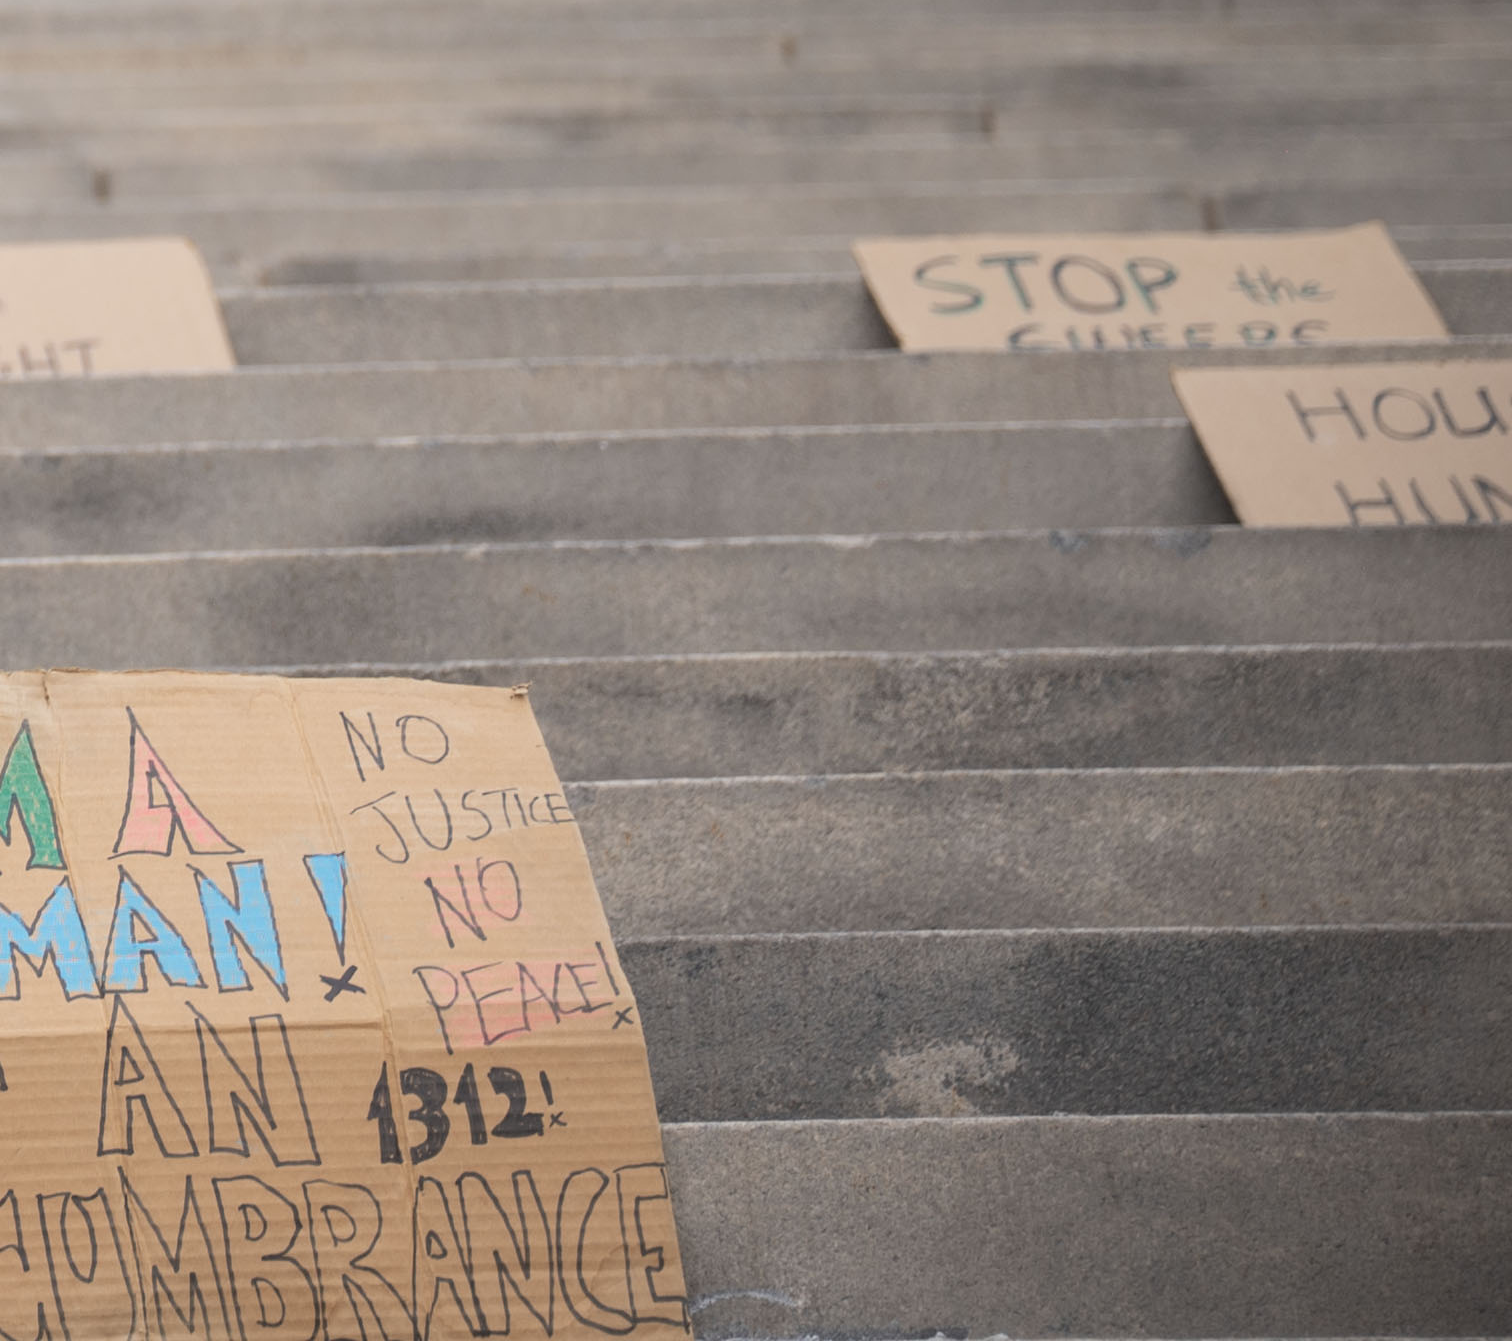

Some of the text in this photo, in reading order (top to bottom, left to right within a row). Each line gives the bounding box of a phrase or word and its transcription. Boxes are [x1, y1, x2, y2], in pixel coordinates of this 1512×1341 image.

[914, 250, 1334, 317] STOP the
[1285, 386, 1512, 443] HOU
[110, 705, 244, 859] A
[339, 710, 449, 782] NO
[349, 788, 577, 864] JUSTICE
[424, 857, 522, 948] NO
[412, 941, 634, 1055] PEACE!
[97, 994, 321, 1166] AN
